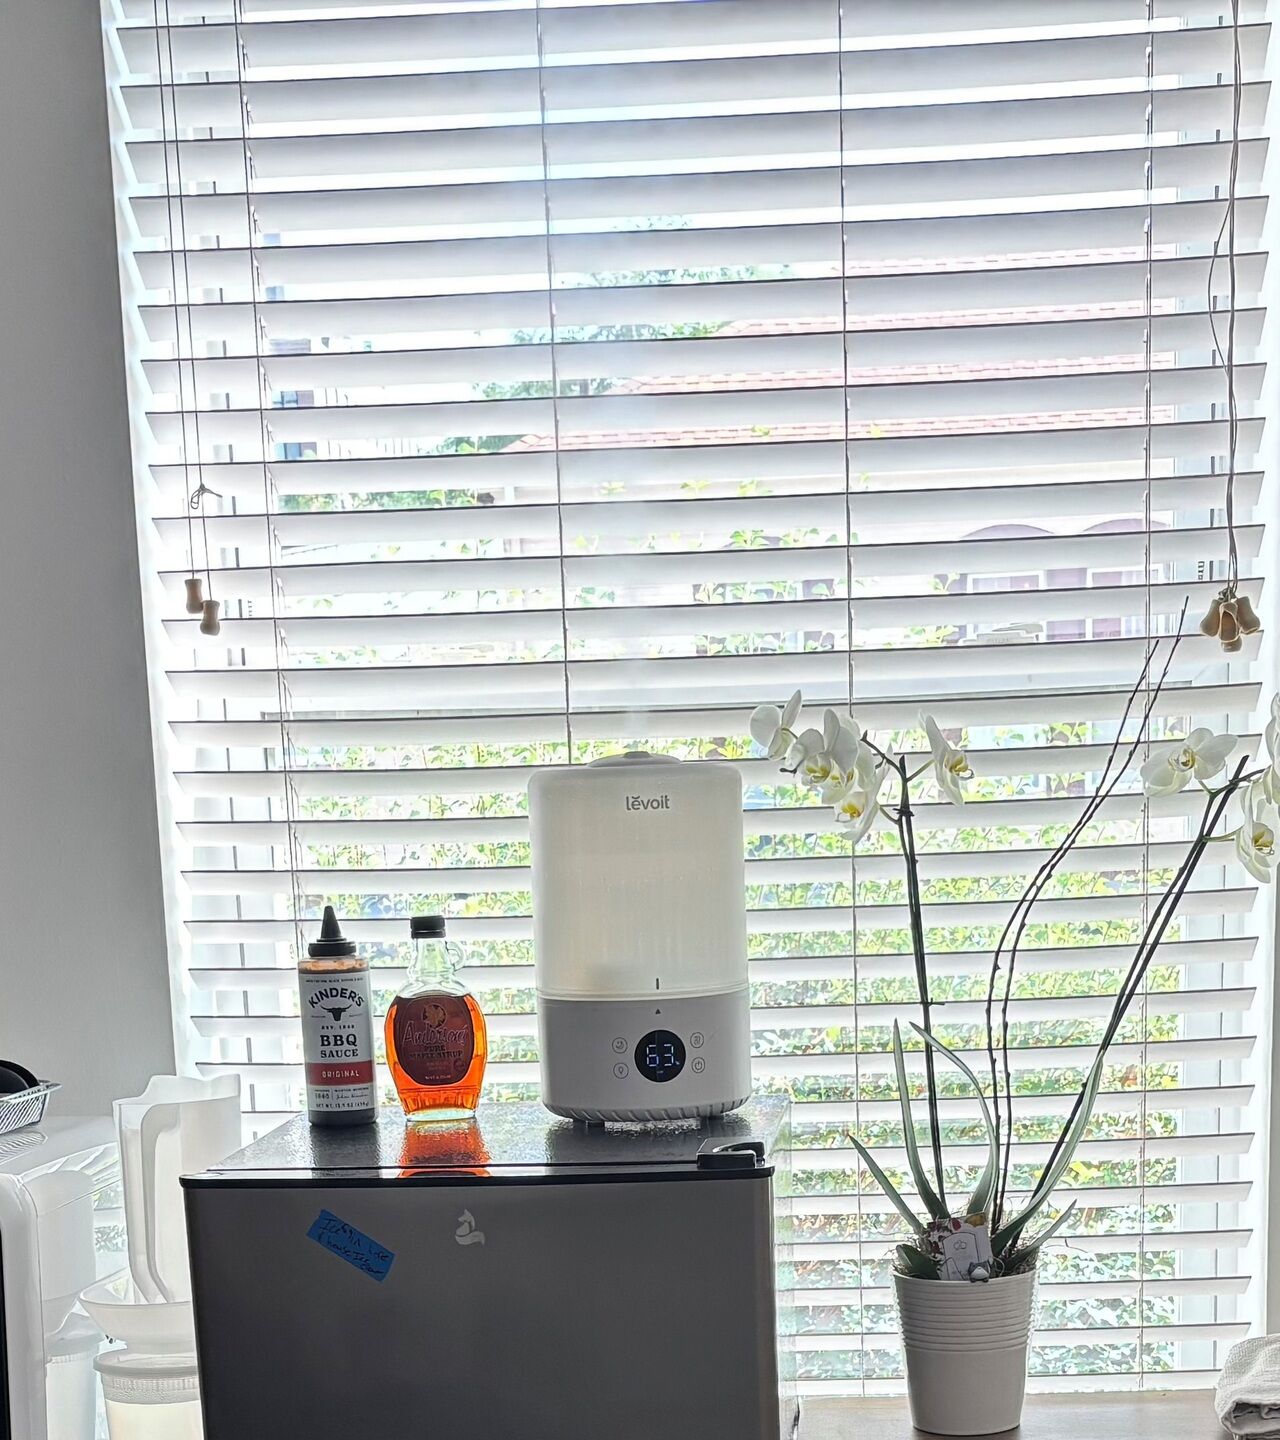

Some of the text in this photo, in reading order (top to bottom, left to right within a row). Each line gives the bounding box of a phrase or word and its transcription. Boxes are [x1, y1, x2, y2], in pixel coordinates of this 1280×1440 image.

[308, 987, 366, 1009] KINDER'S
[320, 1033, 358, 1047] BBQ
[320, 1048, 359, 1058] SAUCE
[321, 1070, 360, 1079] ORIGINAL
